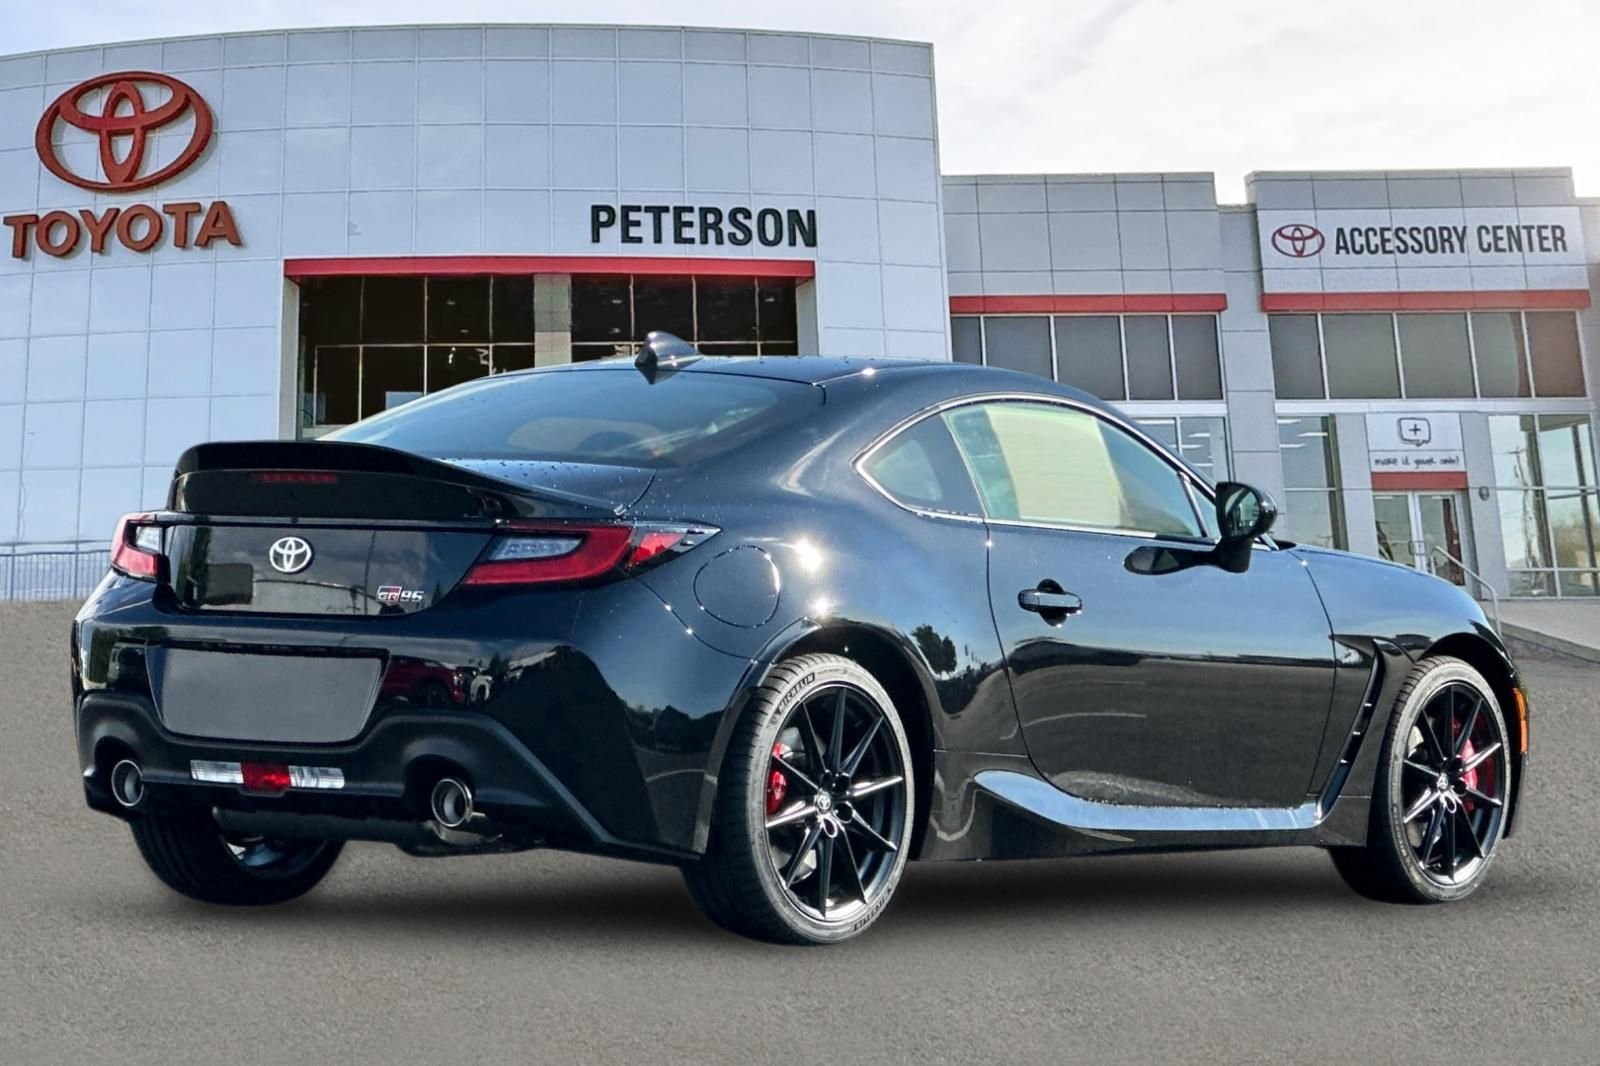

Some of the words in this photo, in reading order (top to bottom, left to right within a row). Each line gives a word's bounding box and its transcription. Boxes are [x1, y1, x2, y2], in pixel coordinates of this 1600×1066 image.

[3, 200, 242, 258] TOYOTA
[591, 204, 817, 247] PETERSON
[1335, 225, 1467, 255] ACCESSORY
[1476, 224, 1568, 253] CENTER
[775, 672, 816, 715] MICHELIN
